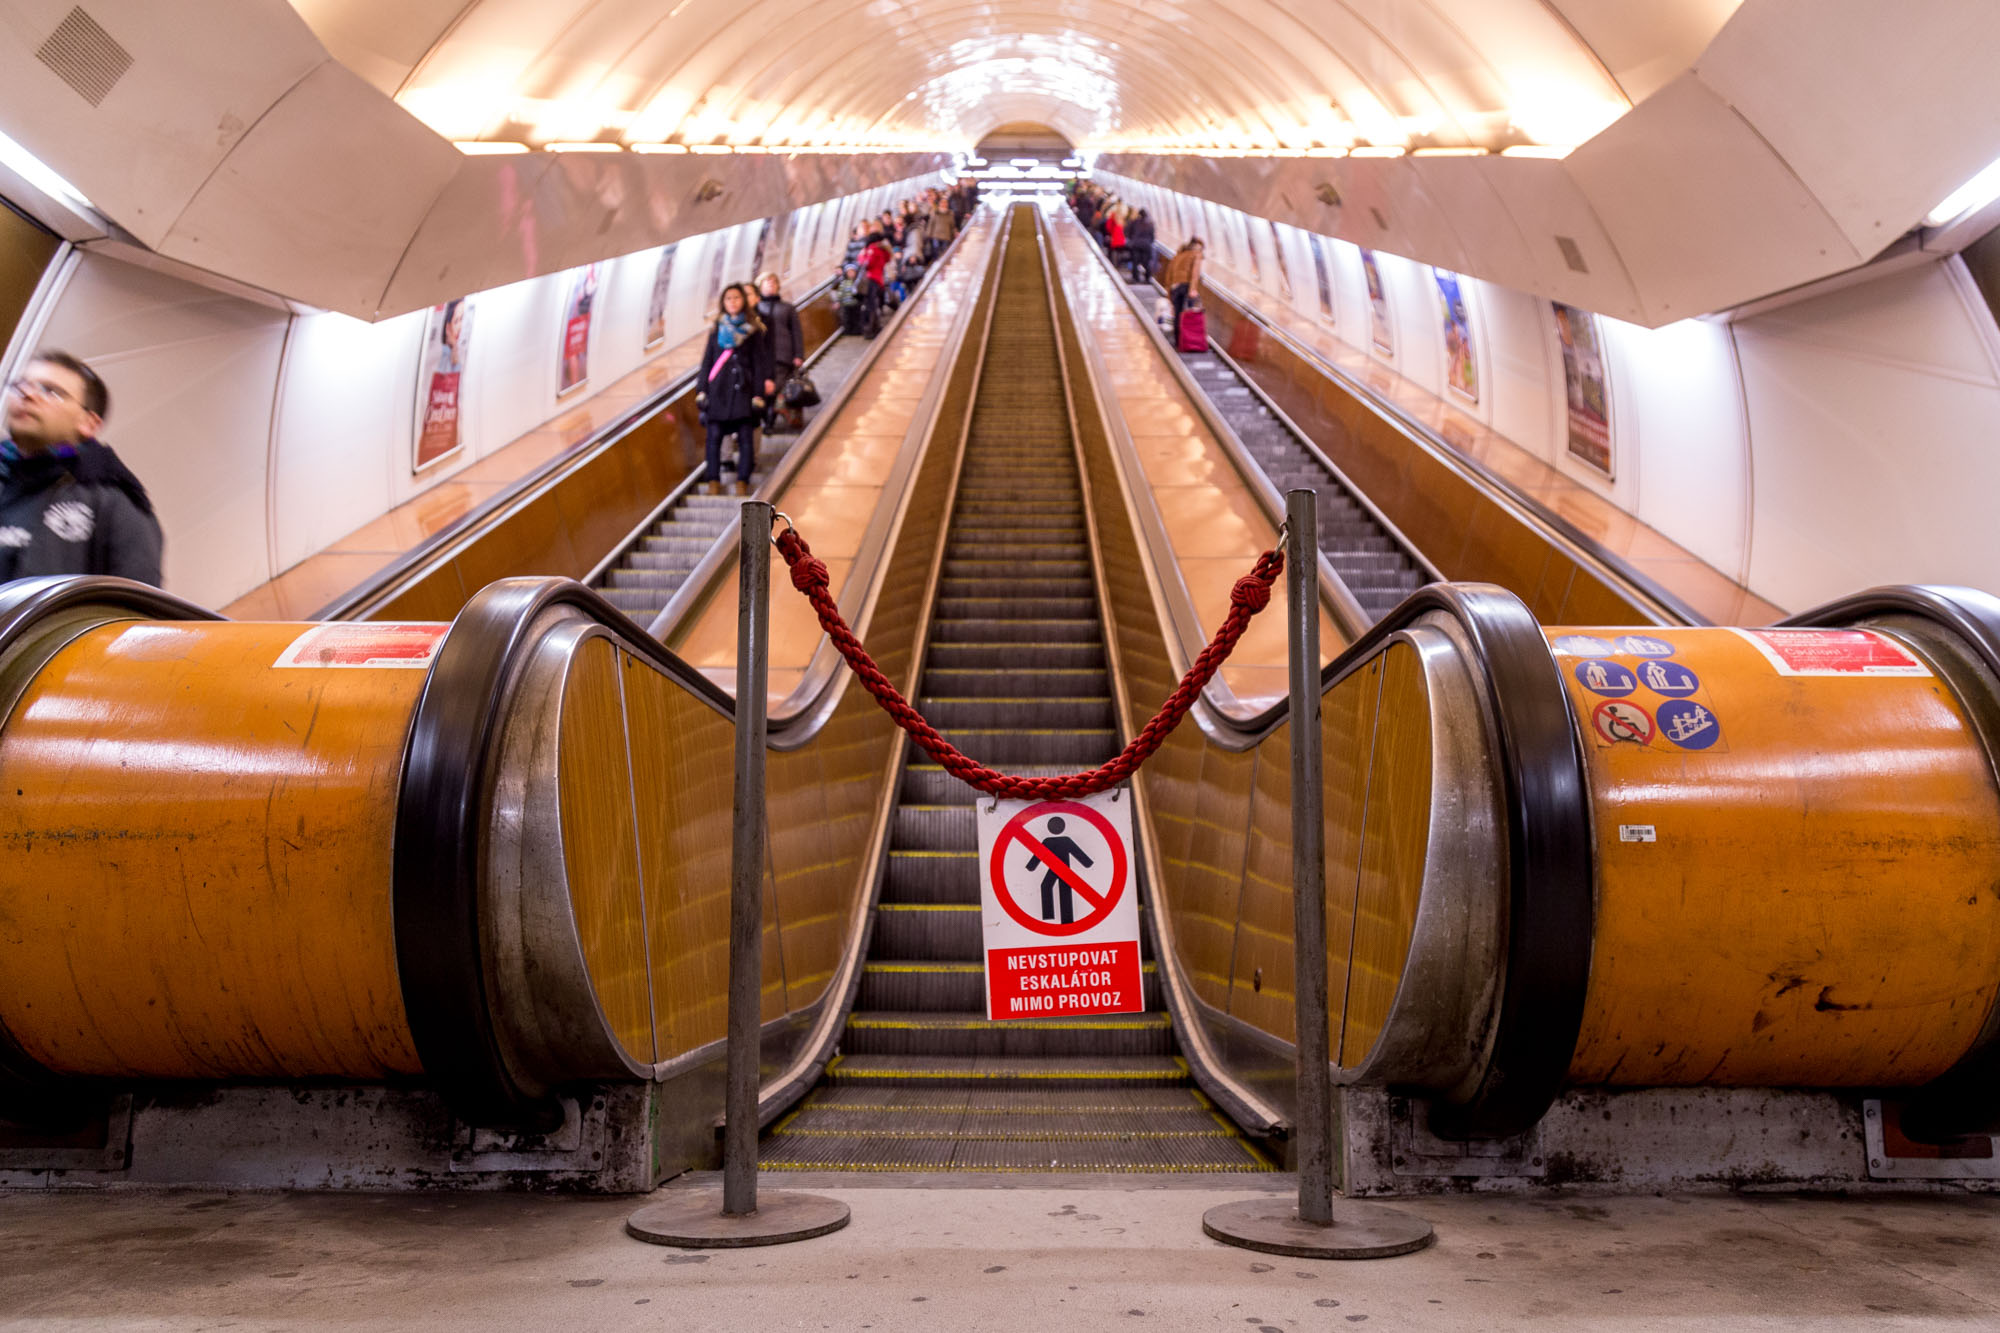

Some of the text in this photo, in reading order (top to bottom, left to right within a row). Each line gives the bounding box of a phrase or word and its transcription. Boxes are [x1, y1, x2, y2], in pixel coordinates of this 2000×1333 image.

[1007, 949, 1118, 970] NEVSTUPOVAT
[1020, 969, 1112, 991] ESKALÁTOR
[1010, 991, 1122, 1012] MIMO PROVOZ
